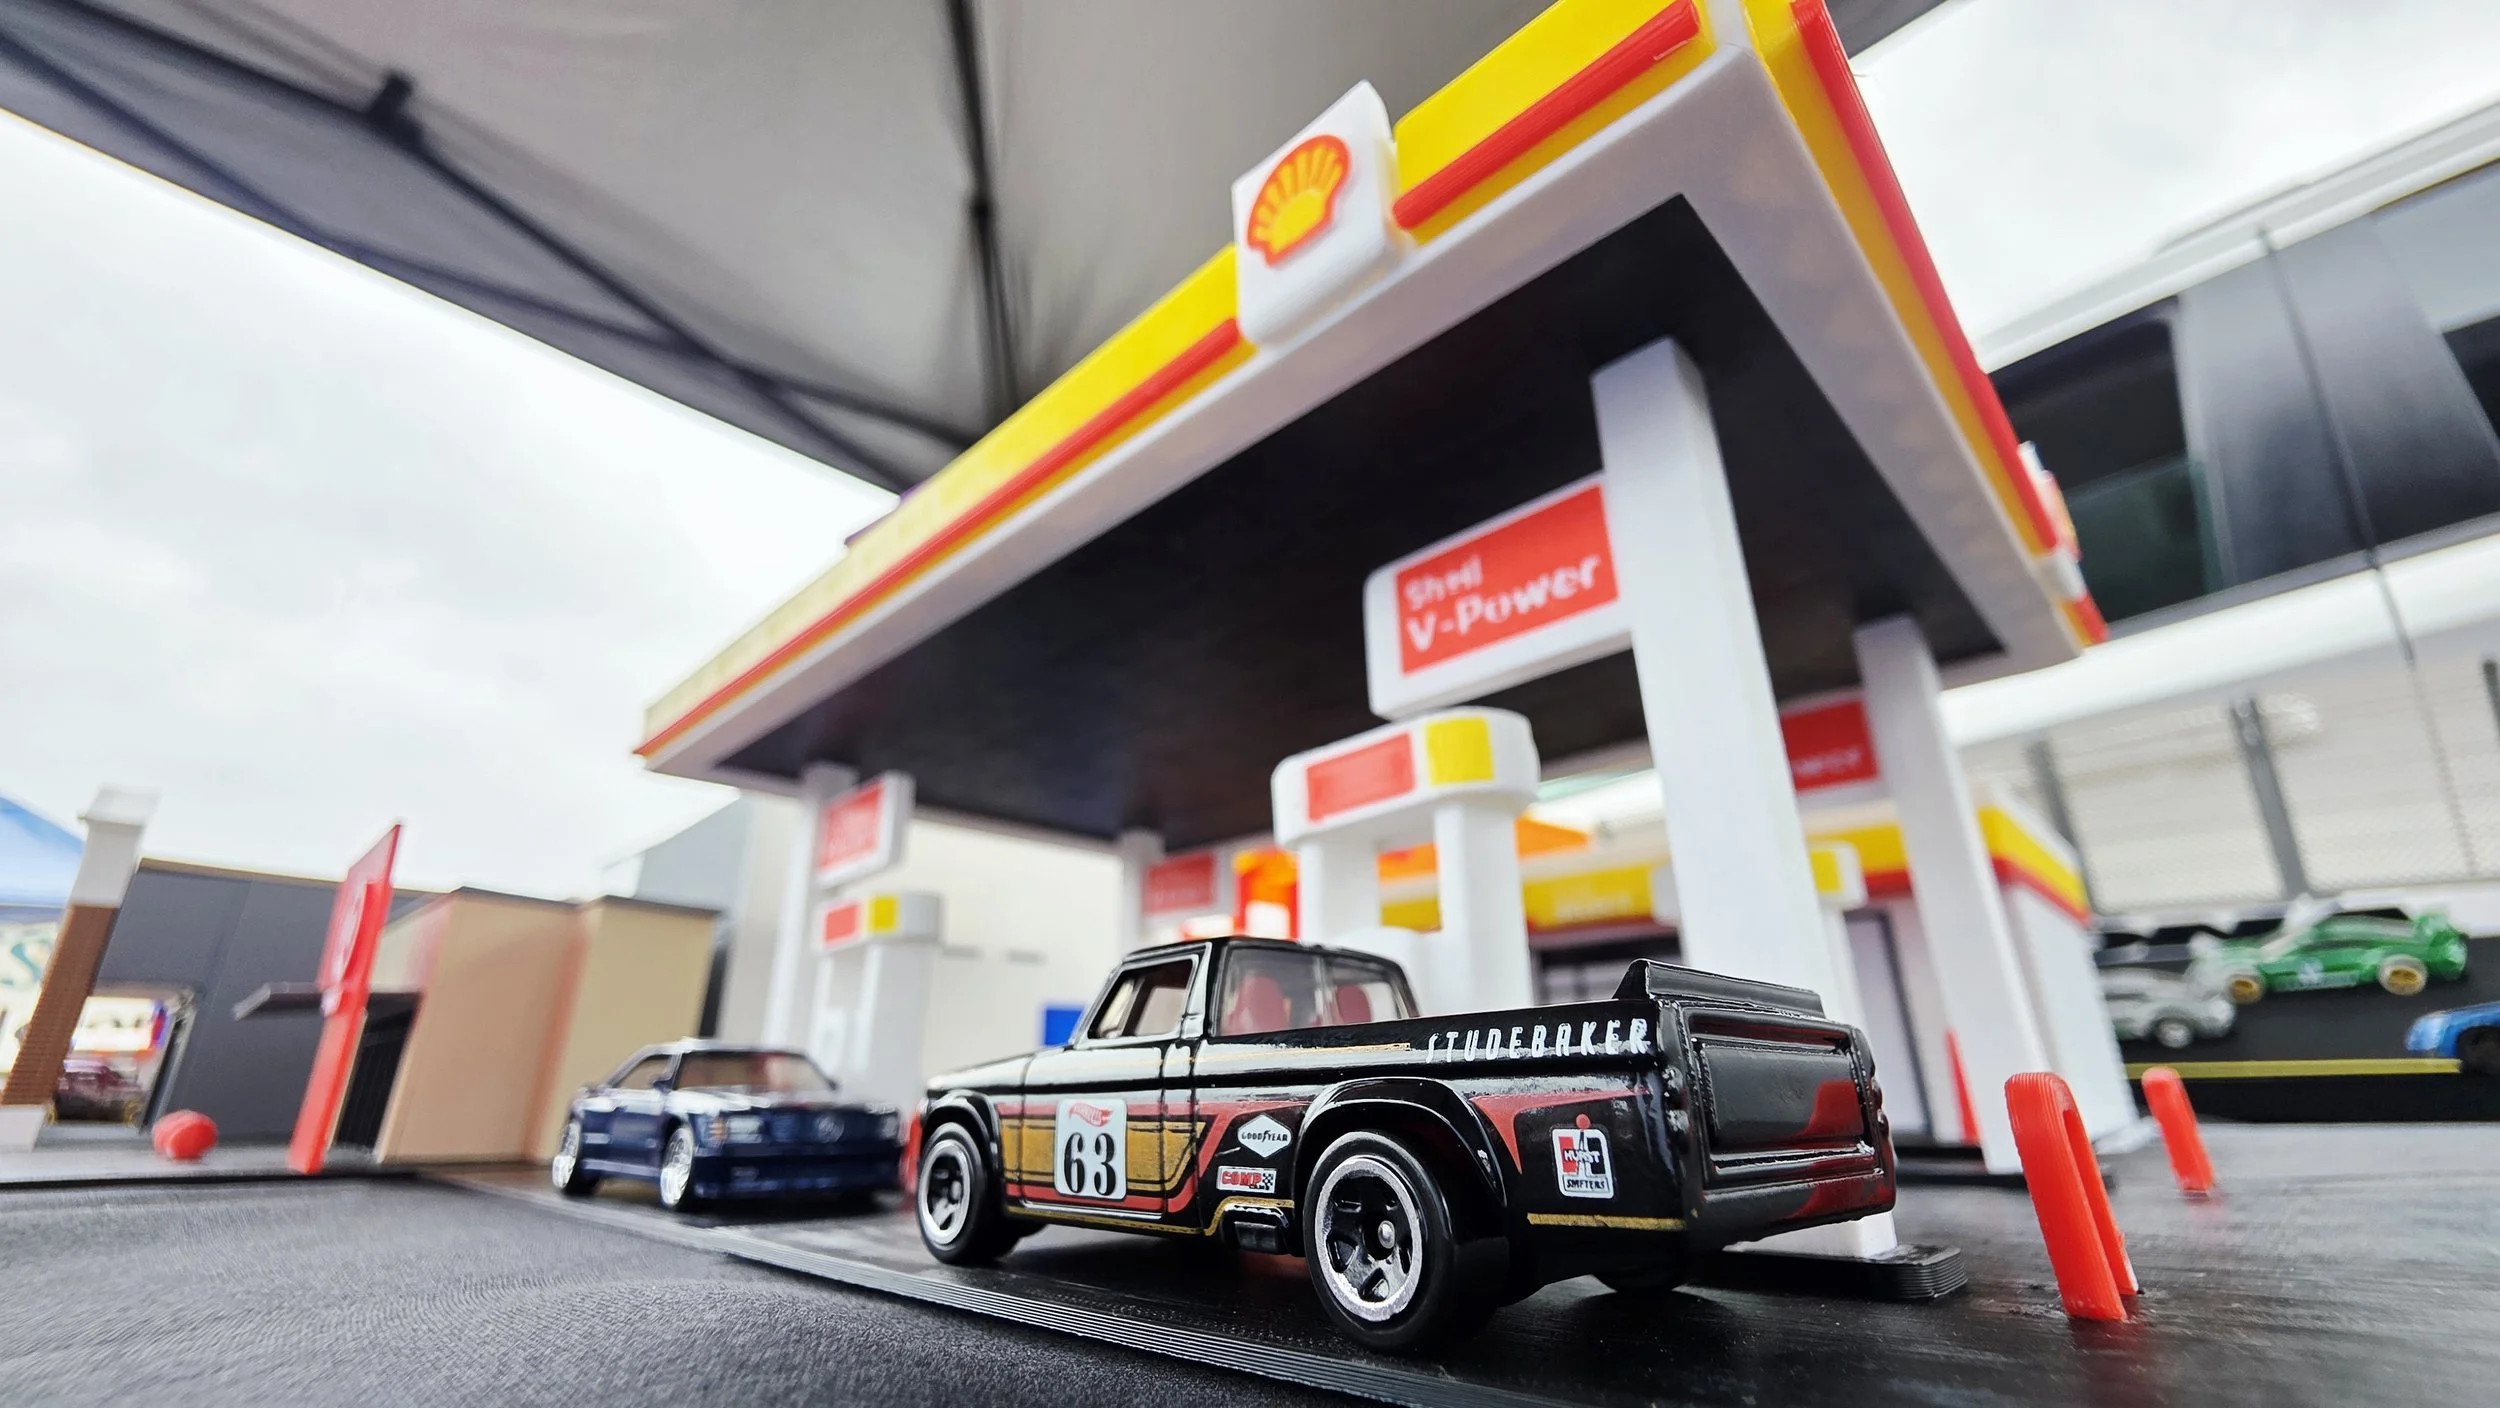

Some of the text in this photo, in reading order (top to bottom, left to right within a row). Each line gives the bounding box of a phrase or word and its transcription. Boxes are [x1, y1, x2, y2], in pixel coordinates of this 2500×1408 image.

[1406, 554, 1599, 652] V-Power
[1426, 1018, 1649, 1063] STUDEBAKER
[1241, 1130, 1288, 1142] GOODYEAR
[1064, 1132, 1116, 1196] 63
[1563, 1150, 1601, 1163] HURST
[1221, 1171, 1262, 1186] COMP
